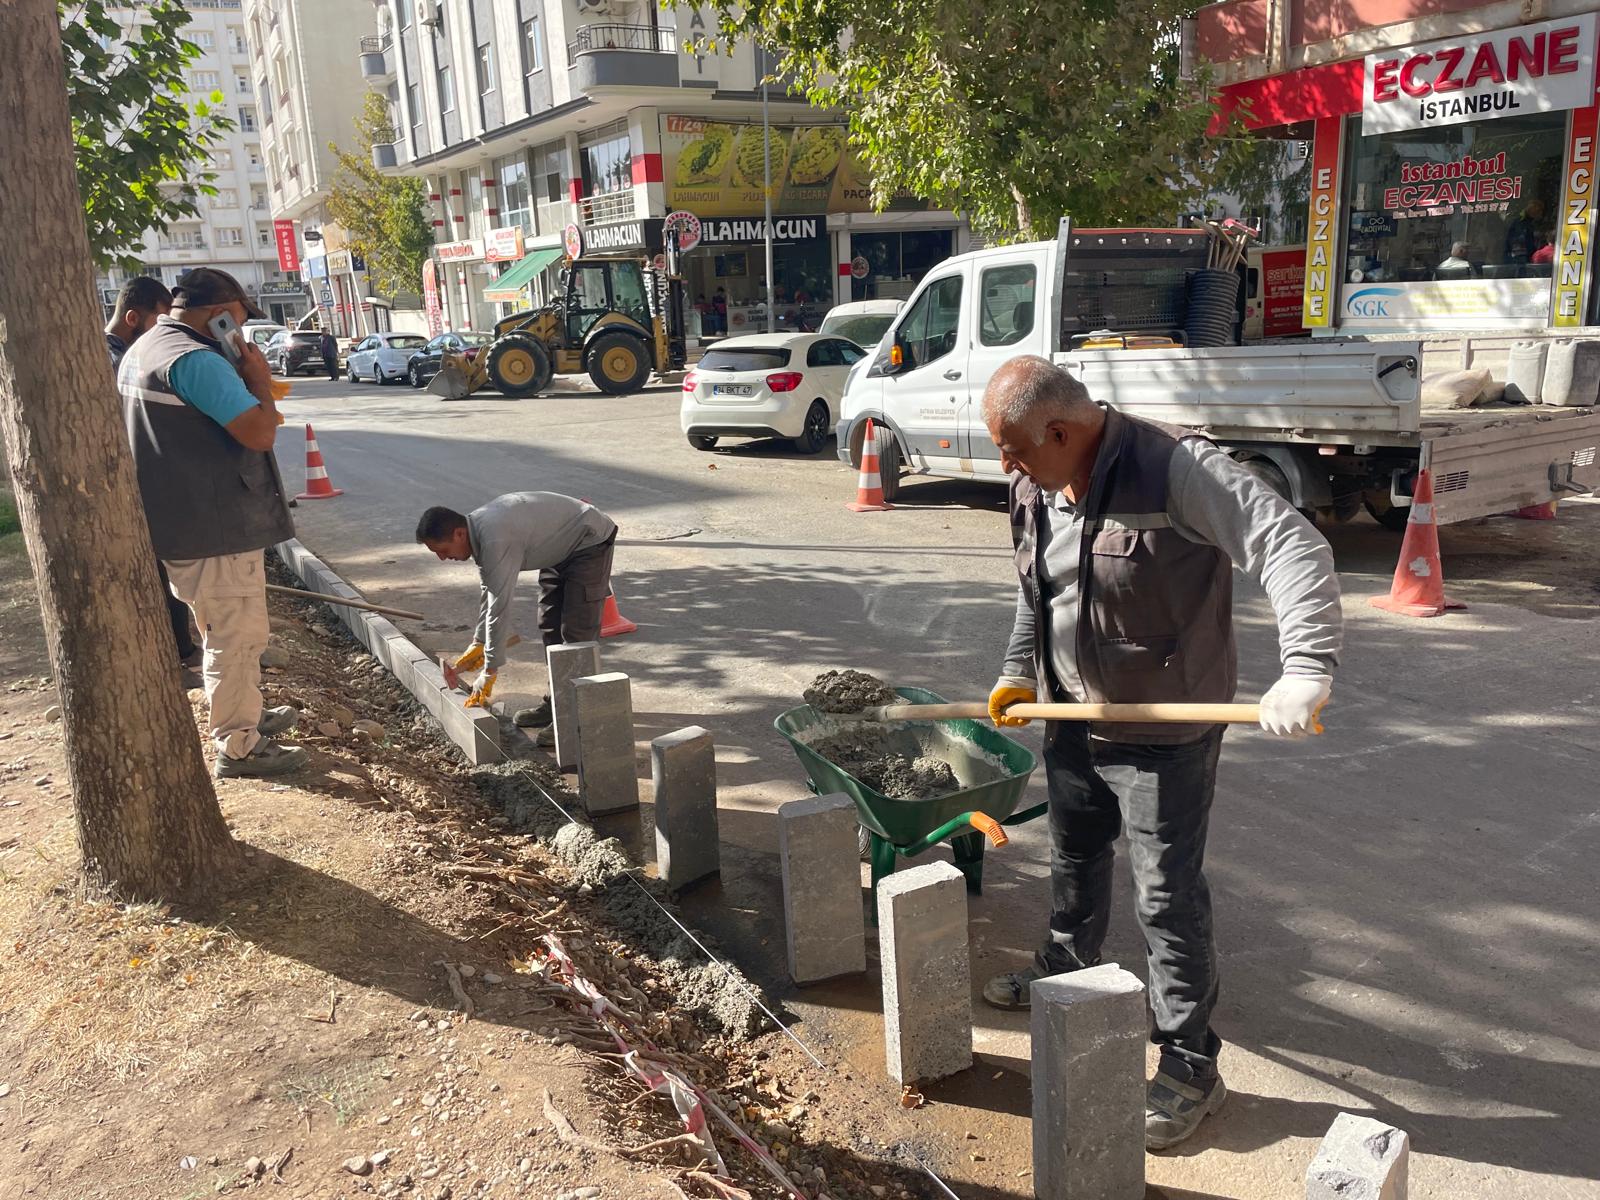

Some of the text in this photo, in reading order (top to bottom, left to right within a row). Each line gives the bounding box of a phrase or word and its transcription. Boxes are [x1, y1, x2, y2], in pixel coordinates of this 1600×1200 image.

[1373, 26, 1580, 103] ECZANE
[1419, 90, 1520, 121] İSTANBUL
[1401, 152, 1506, 184] istanbul
[709, 219, 817, 241] LAHMACUN
[1310, 168, 1332, 318] ECZANE
[1559, 137, 1592, 318] ECZANE
[1353, 300, 1389, 317] SGK
